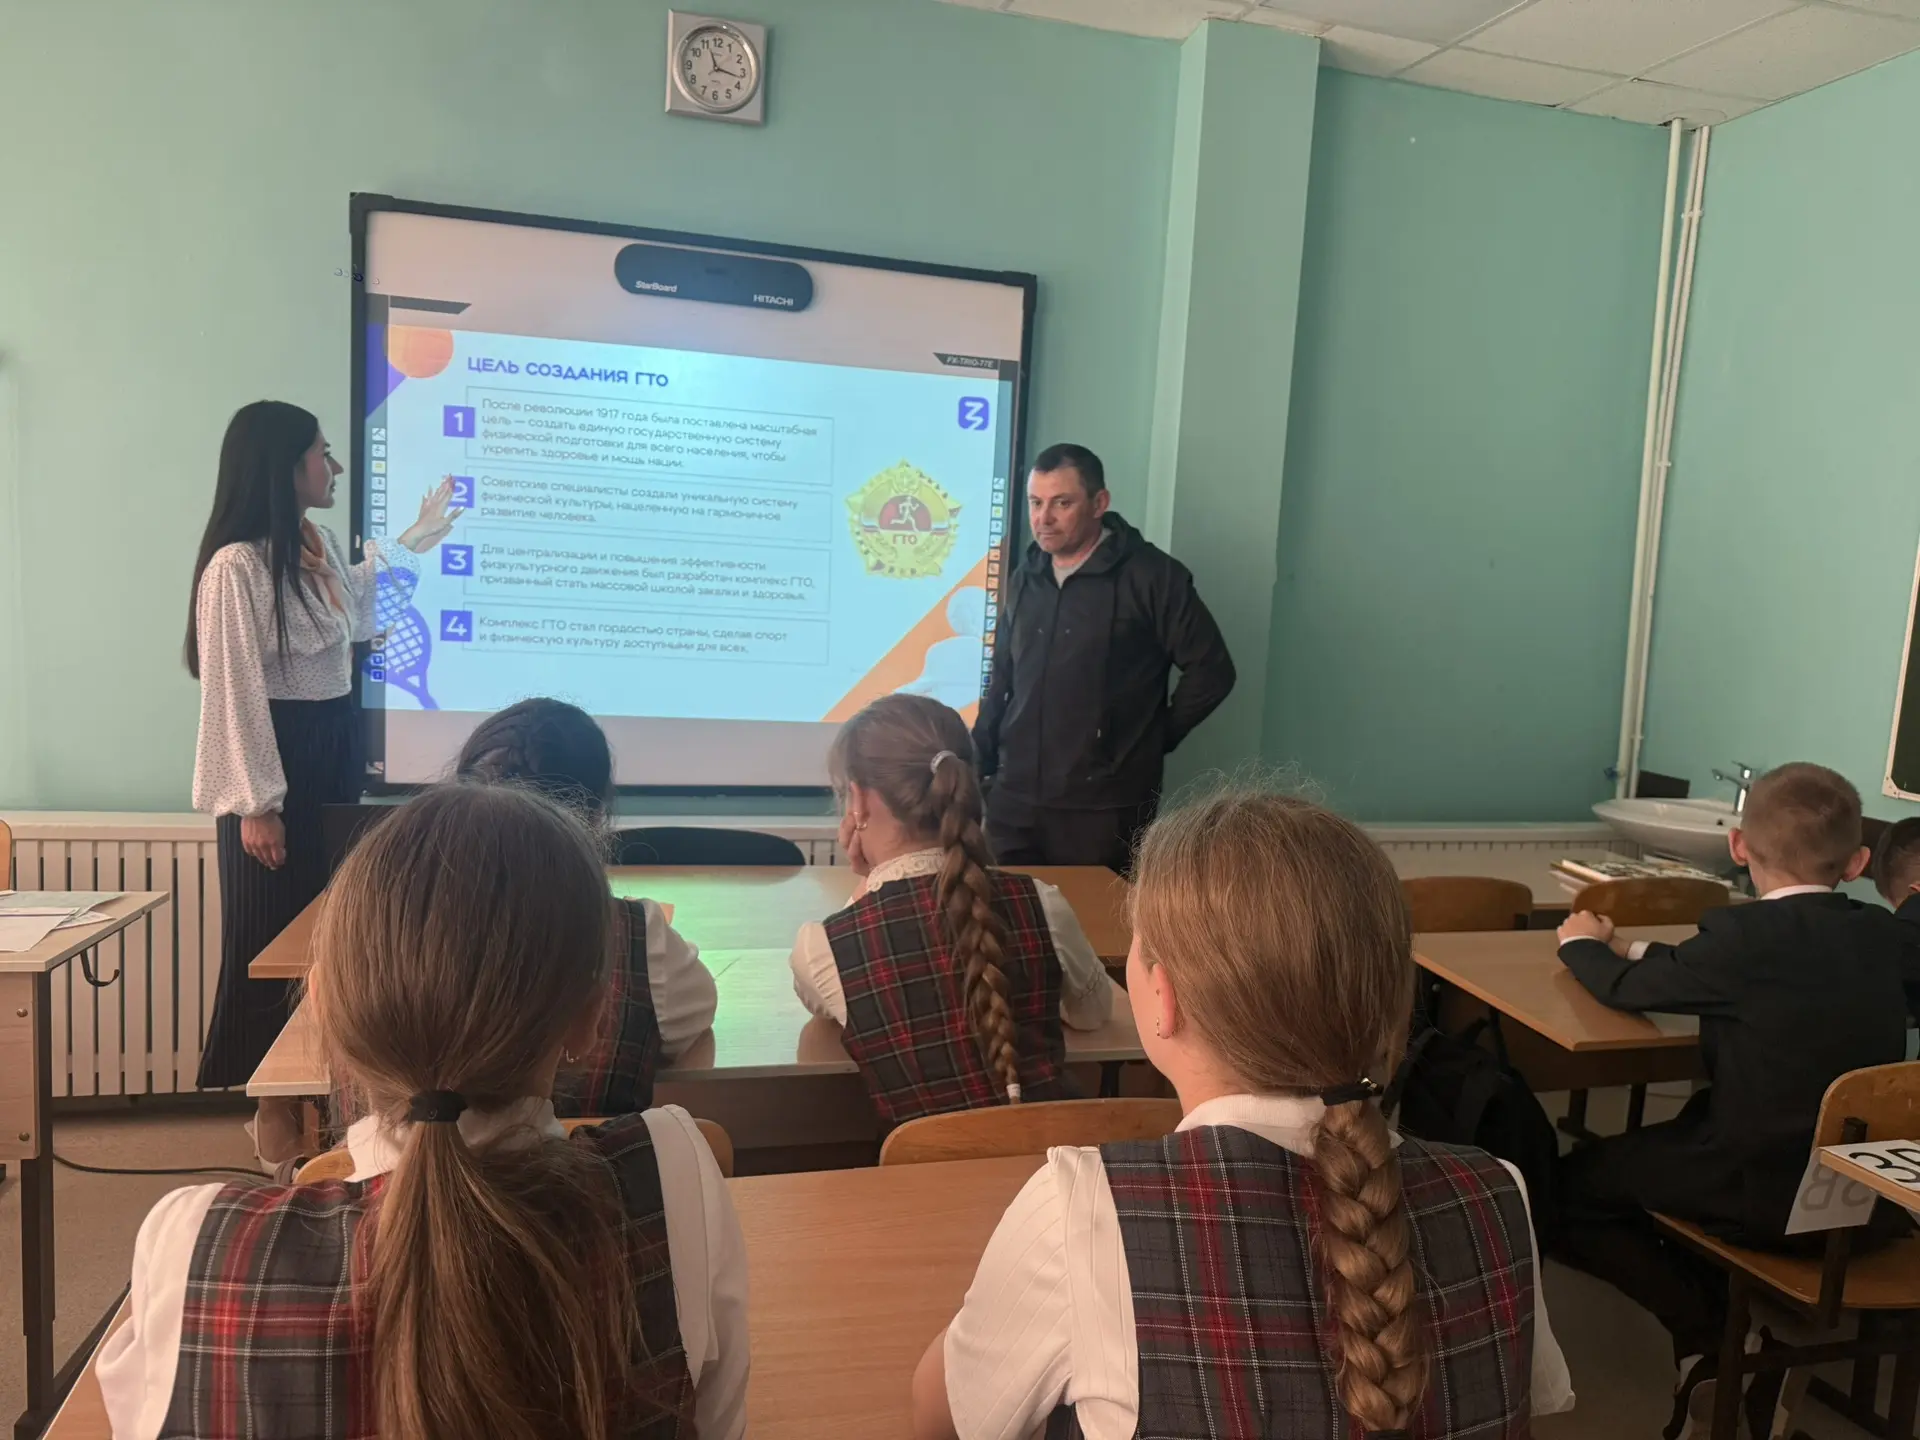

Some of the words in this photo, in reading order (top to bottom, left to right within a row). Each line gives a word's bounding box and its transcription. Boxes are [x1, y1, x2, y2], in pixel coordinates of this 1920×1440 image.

[700, 39, 710, 49] 11
[713, 38, 724, 48] 12
[727, 43, 732, 53] 1
[691, 48, 701, 57] 10
[736, 54, 743, 64] 2
[685, 60, 693, 70] 9
[740, 68, 746, 78] 3
[690, 75, 697, 84] 8
[734, 81, 741, 90] 4
[700, 86, 707, 95] 7
[712, 90, 718, 100] 6
[725, 89, 732, 99] 5
[635, 280, 678, 293] StarBoard
[753, 294, 794, 306] HITACHI
[468, 356, 519, 375] ЦЕЛЬ
[525, 361, 628, 384] СОЗДАНИЯ
[635, 371, 669, 388] ГТО
[453, 411, 464, 432] 1
[482, 399, 521, 412] После
[524, 402, 593, 417] революции
[596, 408, 619, 419] 1917
[622, 411, 648, 423] года
[651, 412, 680, 425] была
[682, 416, 747, 430] поставлена
[750, 422, 817, 436] масштабная
[482, 414, 511, 426] цель
[528, 417, 576, 431] создать
[578, 424, 625, 437] единую
[628, 427, 732, 445] государственную
[735, 435, 782, 449] систему
[482, 429, 552, 443] физической
[556, 434, 624, 449] подготовки
[626, 441, 648, 451] для
[650, 444, 684, 455] всего
[687, 446, 749, 461] населения,
[752, 451, 786, 462] чтобы
[482, 443, 538, 457] укрепить
[541, 448, 598, 462] здоровье
[601, 453, 609, 462] и
[612, 454, 645, 466] мощь
[451, 482, 468, 502] 2
[482, 475, 548, 490] Советские
[550, 481, 629, 497] специалисты
[632, 488, 678, 500] создали
[681, 491, 749, 506] уникальную
[752, 496, 798, 510] систему
[481, 492, 552, 506] физической
[555, 496, 614, 511] культуры,
[616, 502, 689, 516] нацеленную
[692, 507, 705, 517] на
[708, 508, 781, 522] гармоничное
[481, 506, 536, 519] развитие
[892, 534, 918, 546] ГТО
[447, 548, 467, 571] 3
[480, 543, 505, 556] Для
[507, 546, 598, 562] централизации
[600, 552, 608, 561] и
[610, 553, 678, 566] повышения
[680, 557, 767, 572] эффективности
[480, 558, 578, 574] физкультурного
[580, 565, 639, 578] движения
[642, 568, 664, 579] был
[667, 570, 733, 584] разработан
[735, 575, 788, 587] комплекс
[790, 576, 816, 589] ГТО,
[480, 574, 553, 588] призванный
[556, 578, 588, 589] стать
[590, 580, 648, 592] массовой
[650, 584, 695, 596] школой
[697, 587, 740, 598] закалки
[445, 615, 468, 637] 4
[480, 616, 539, 630] Комплекс
[541, 618, 567, 631] ГТО
[569, 622, 596, 632] стал
[598, 624, 664, 637] гордостью
[666, 626, 710, 639] страны,
[754, 631, 788, 643] спорт
[479, 633, 487, 642] и
[490, 631, 564, 646] физическую
[566, 636, 620, 650] культуру
[623, 639, 695, 652] доступными
[696, 642, 717, 653] для
